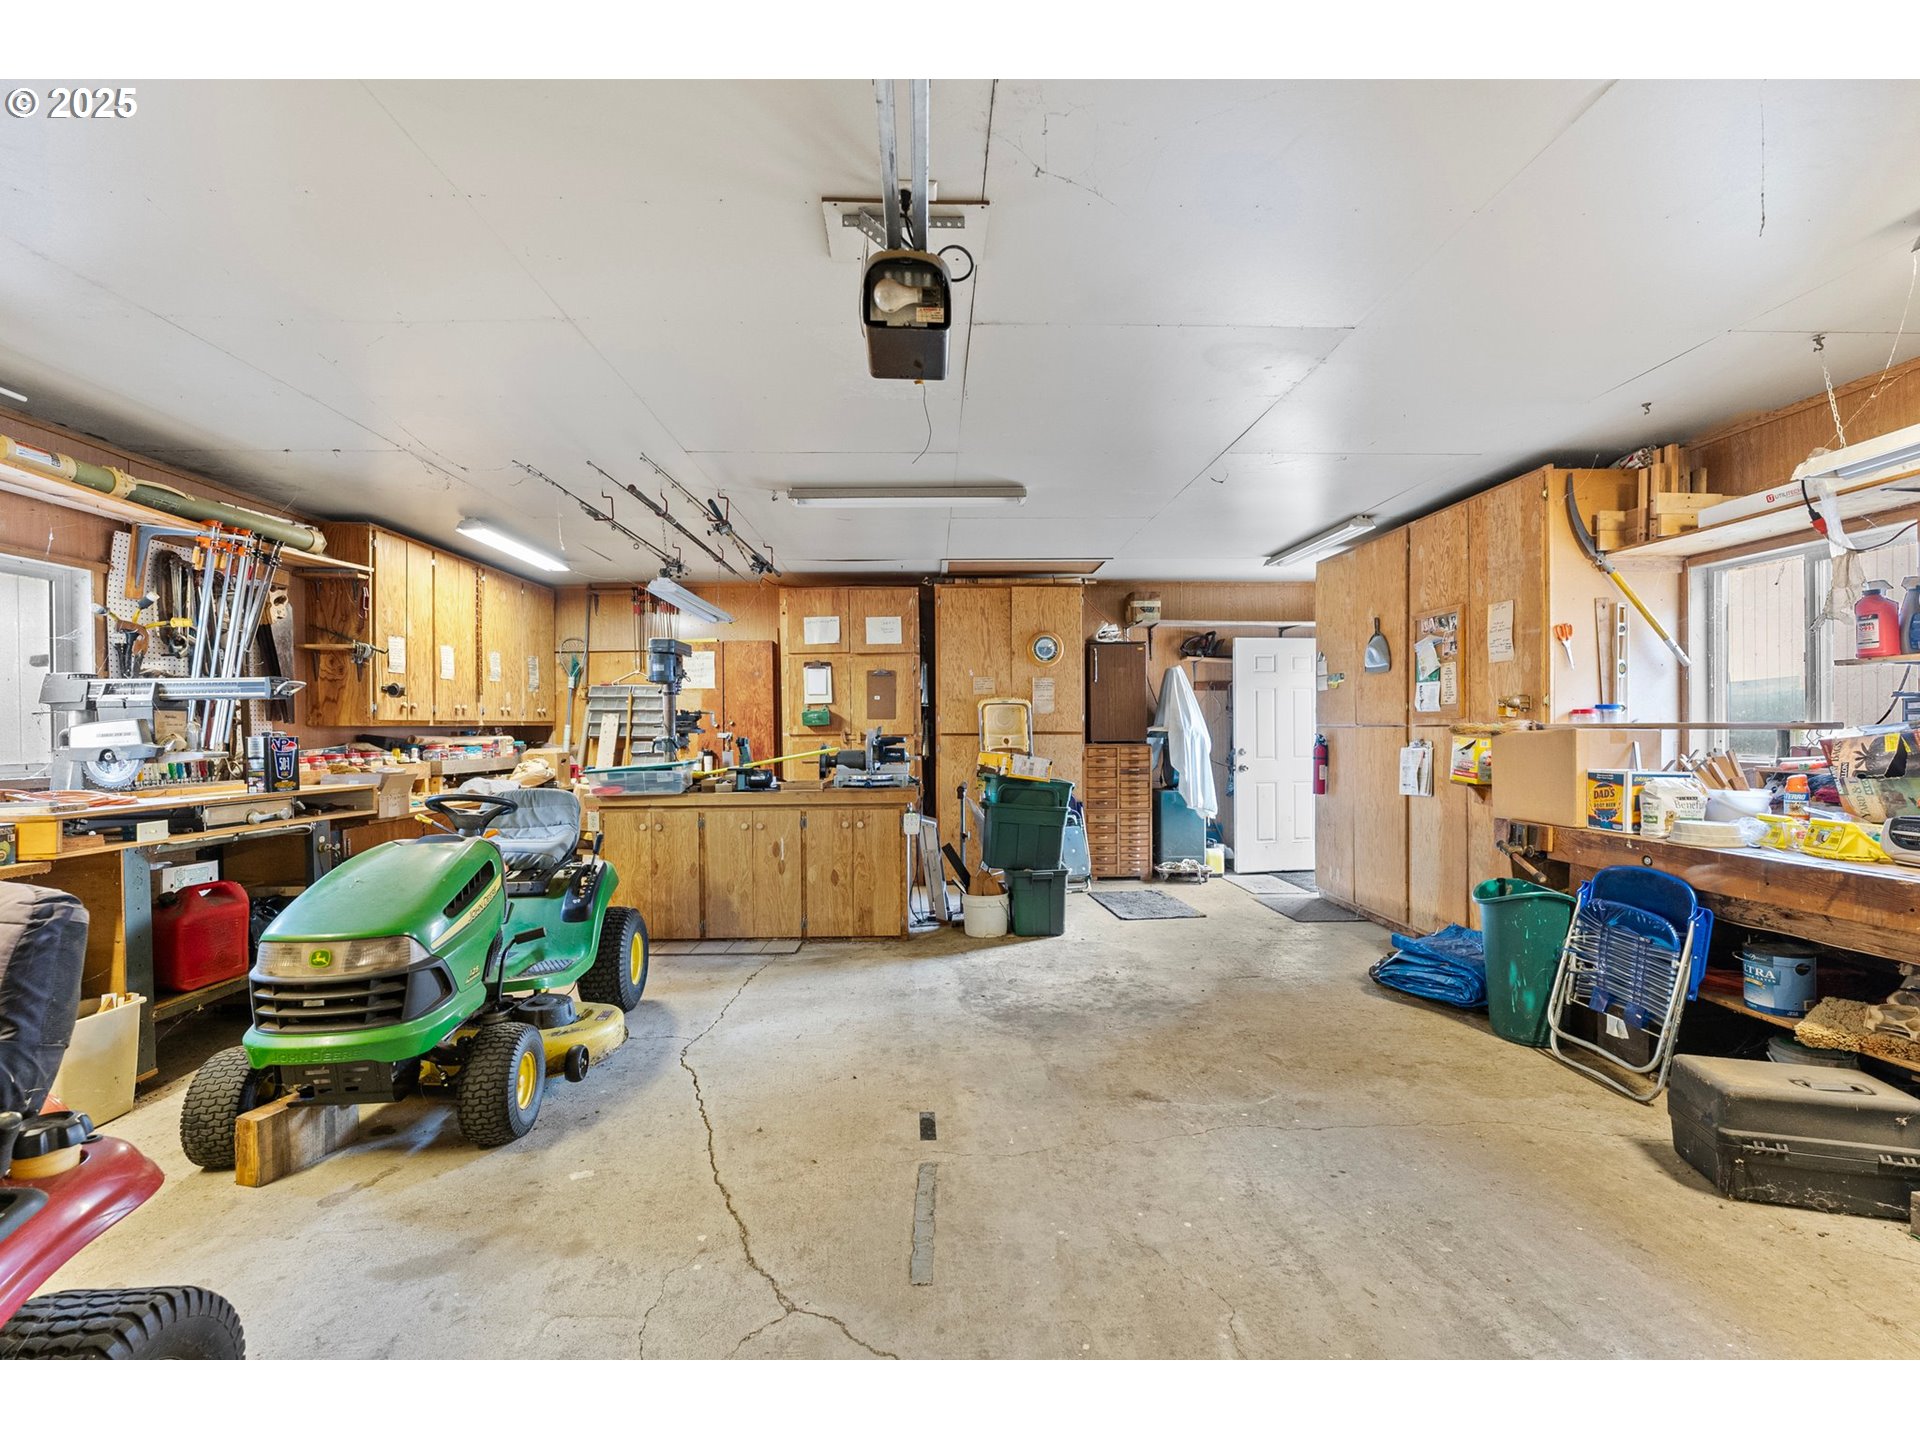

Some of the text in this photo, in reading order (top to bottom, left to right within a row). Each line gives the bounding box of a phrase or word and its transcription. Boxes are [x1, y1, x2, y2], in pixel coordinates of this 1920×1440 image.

[1594, 787, 1615, 799] DAD'S
[1784, 793, 1806, 801] TERRO
[1744, 963, 1776, 980] LTRA
